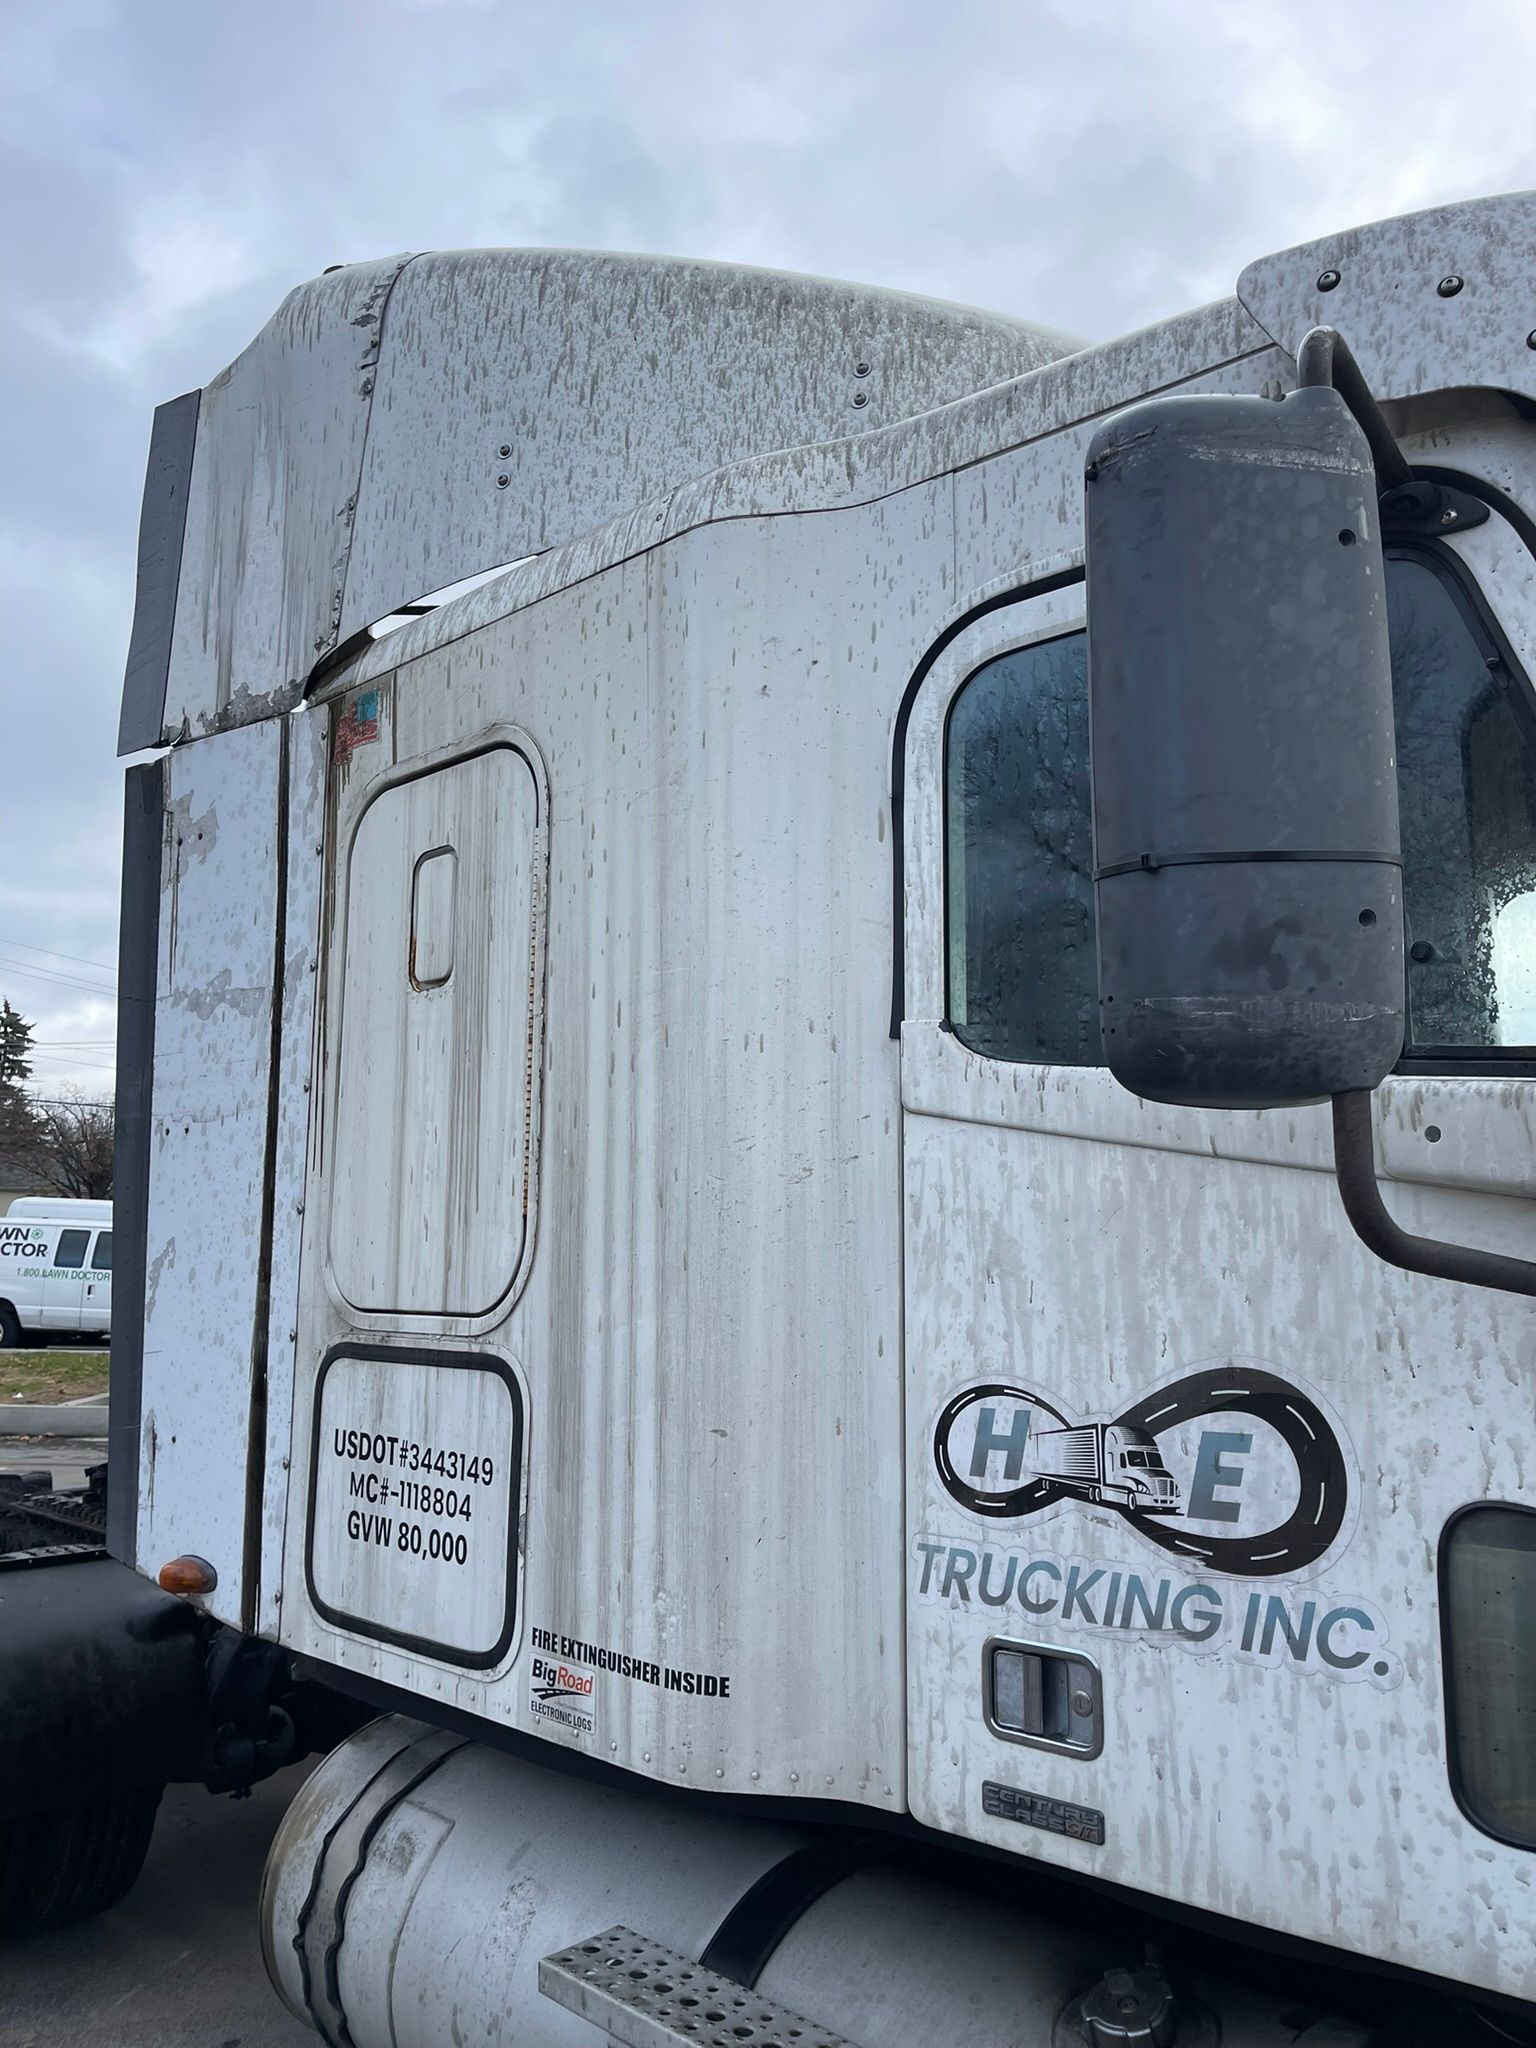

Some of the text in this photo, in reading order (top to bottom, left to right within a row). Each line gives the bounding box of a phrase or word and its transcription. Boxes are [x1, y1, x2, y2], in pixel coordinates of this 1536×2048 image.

[71, 1270, 111, 1281] DOCTOR
[334, 1428, 493, 1486] USDOT#3443149
[969, 1407, 1253, 1523] H E
[350, 1471, 471, 1522] MC#-1118804
[347, 1510, 467, 1565] GVW 80,000
[916, 1542, 1389, 1676] TRUCKING INC.
[532, 1627, 730, 1698] FIRE EXTINGUISHER INSIDE
[532, 1658, 593, 1694] BigRoad
[531, 1700, 572, 1724] ELECTRONIC
[573, 1715, 592, 1731] LOGS
[983, 1785, 1098, 1825] CENTURY
[983, 1800, 1065, 1832] CLASS
